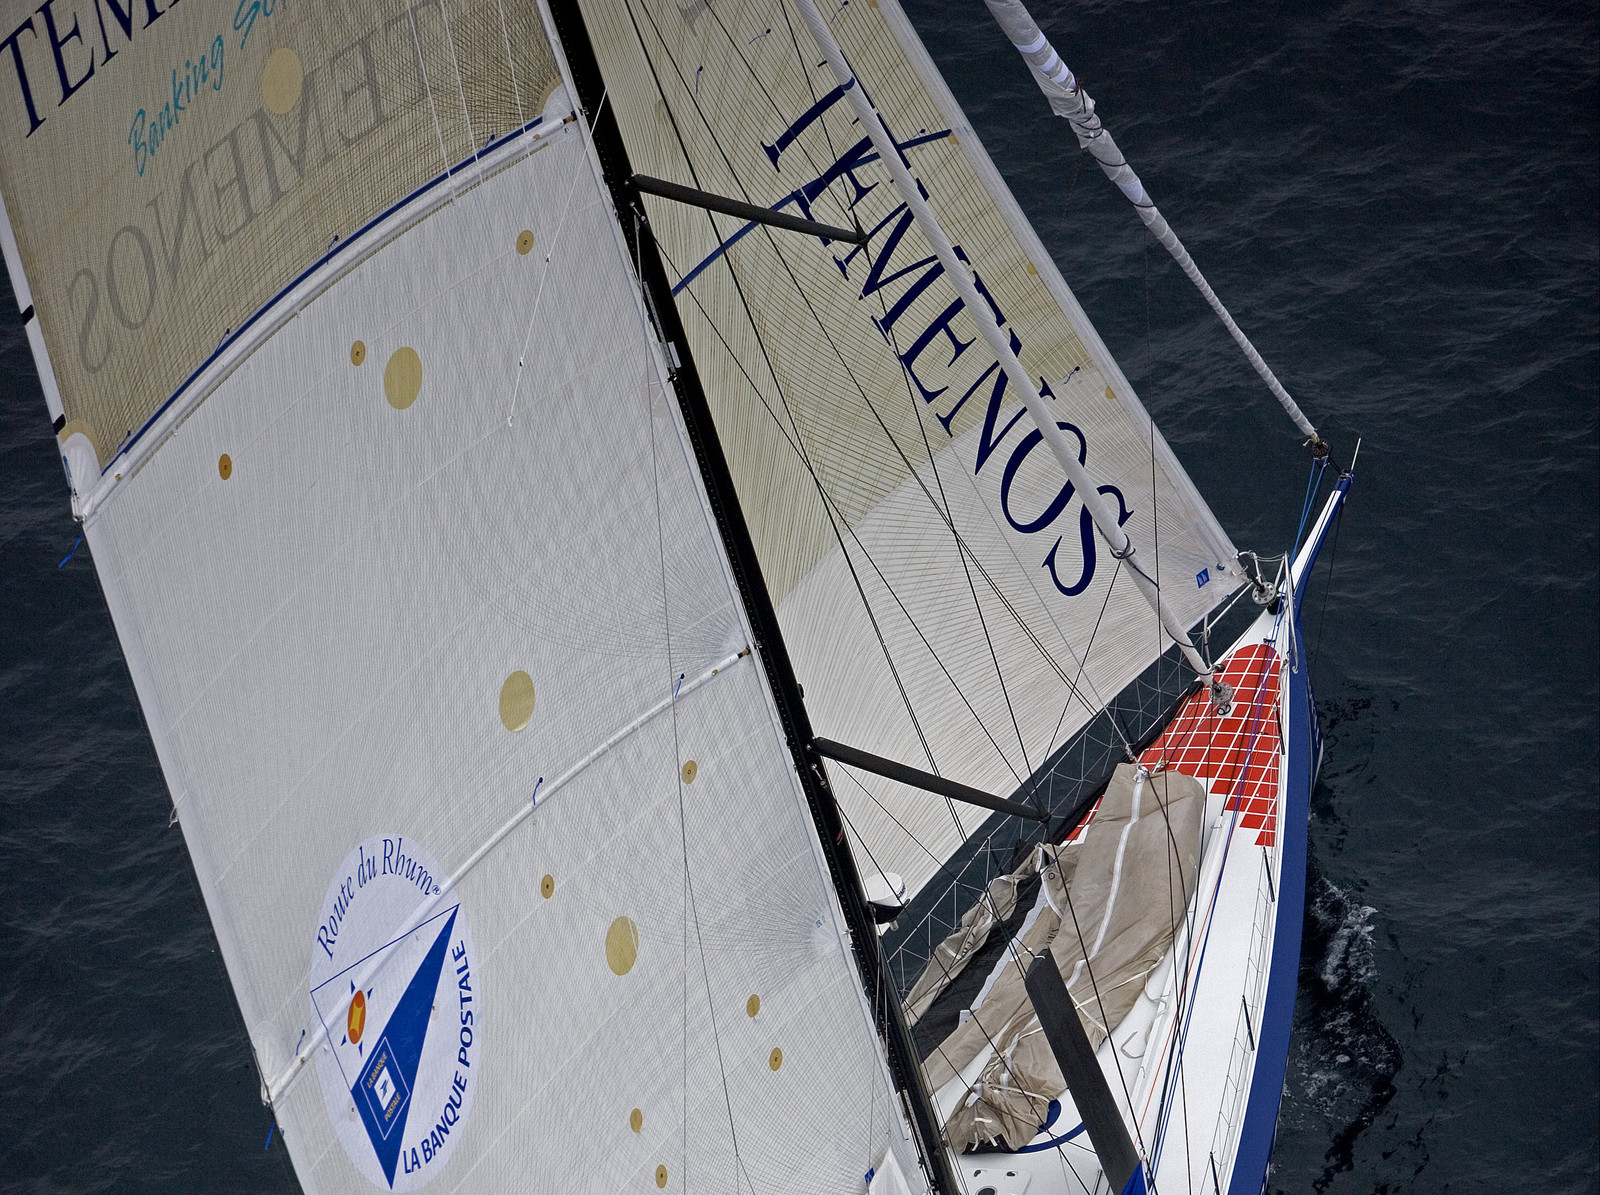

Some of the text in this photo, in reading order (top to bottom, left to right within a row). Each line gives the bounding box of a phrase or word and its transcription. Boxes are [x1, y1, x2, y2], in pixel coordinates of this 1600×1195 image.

[0, 0, 180, 138] TEM
[128, 0, 286, 177] Banking So
[760, 50, 1134, 596] TEMENOS
[316, 874, 355, 962] Route
[357, 846, 379, 890] du
[402, 939, 475, 1176] LA BANQUE POSTALE
